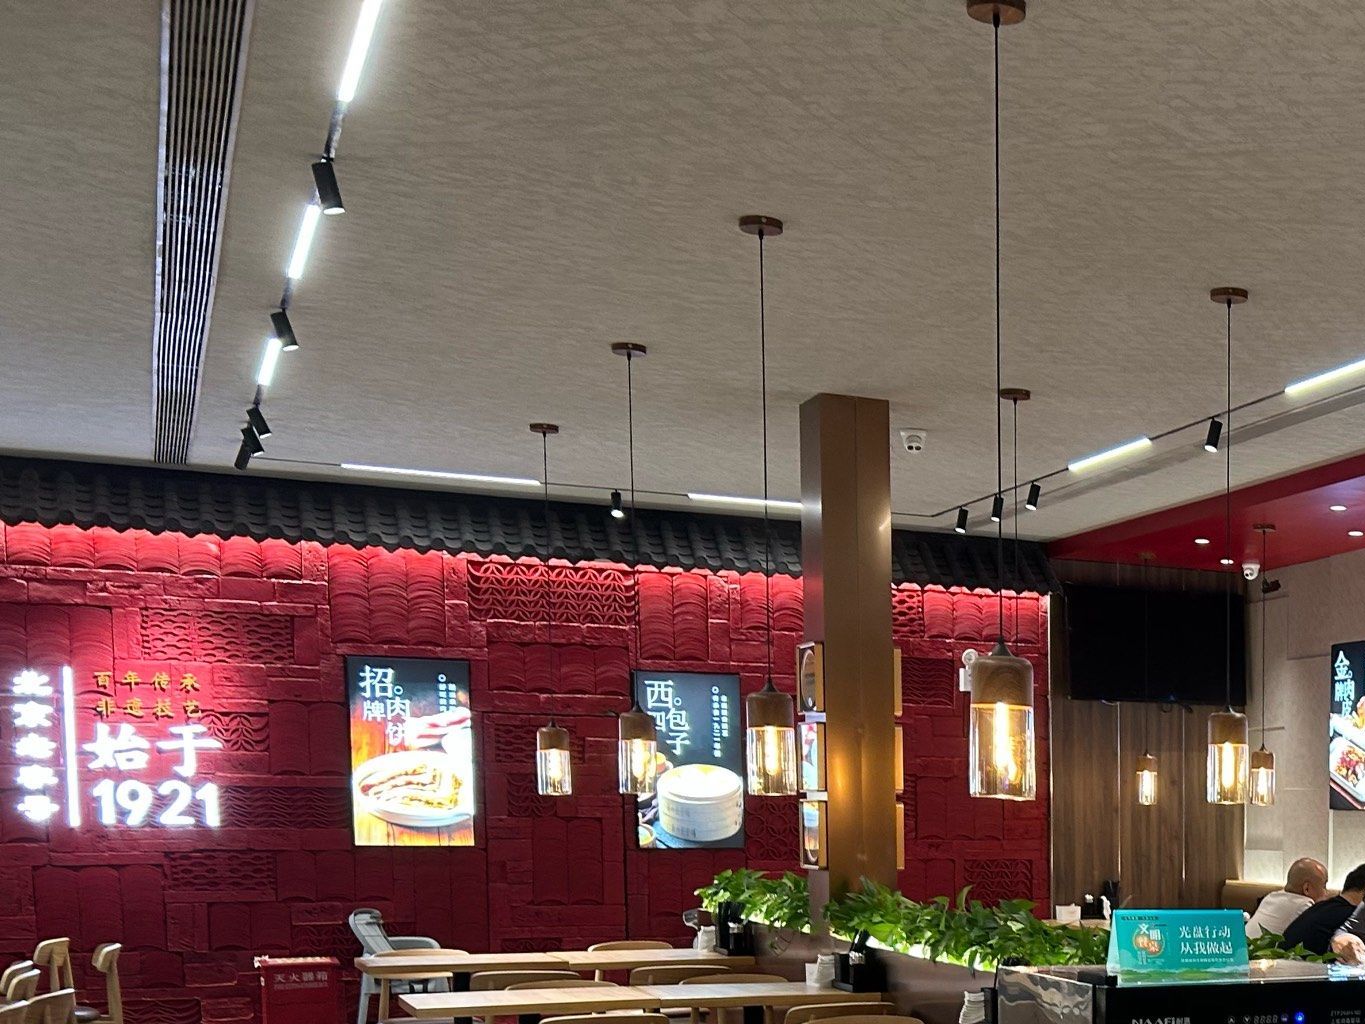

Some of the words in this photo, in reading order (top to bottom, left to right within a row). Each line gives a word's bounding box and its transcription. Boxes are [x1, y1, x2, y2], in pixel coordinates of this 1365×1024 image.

[93, 671, 200, 692] 百年传承
[82, 722, 224, 777] 始于
[92, 778, 221, 827] 1921
[1180, 941, 1233, 955] 从我做起
